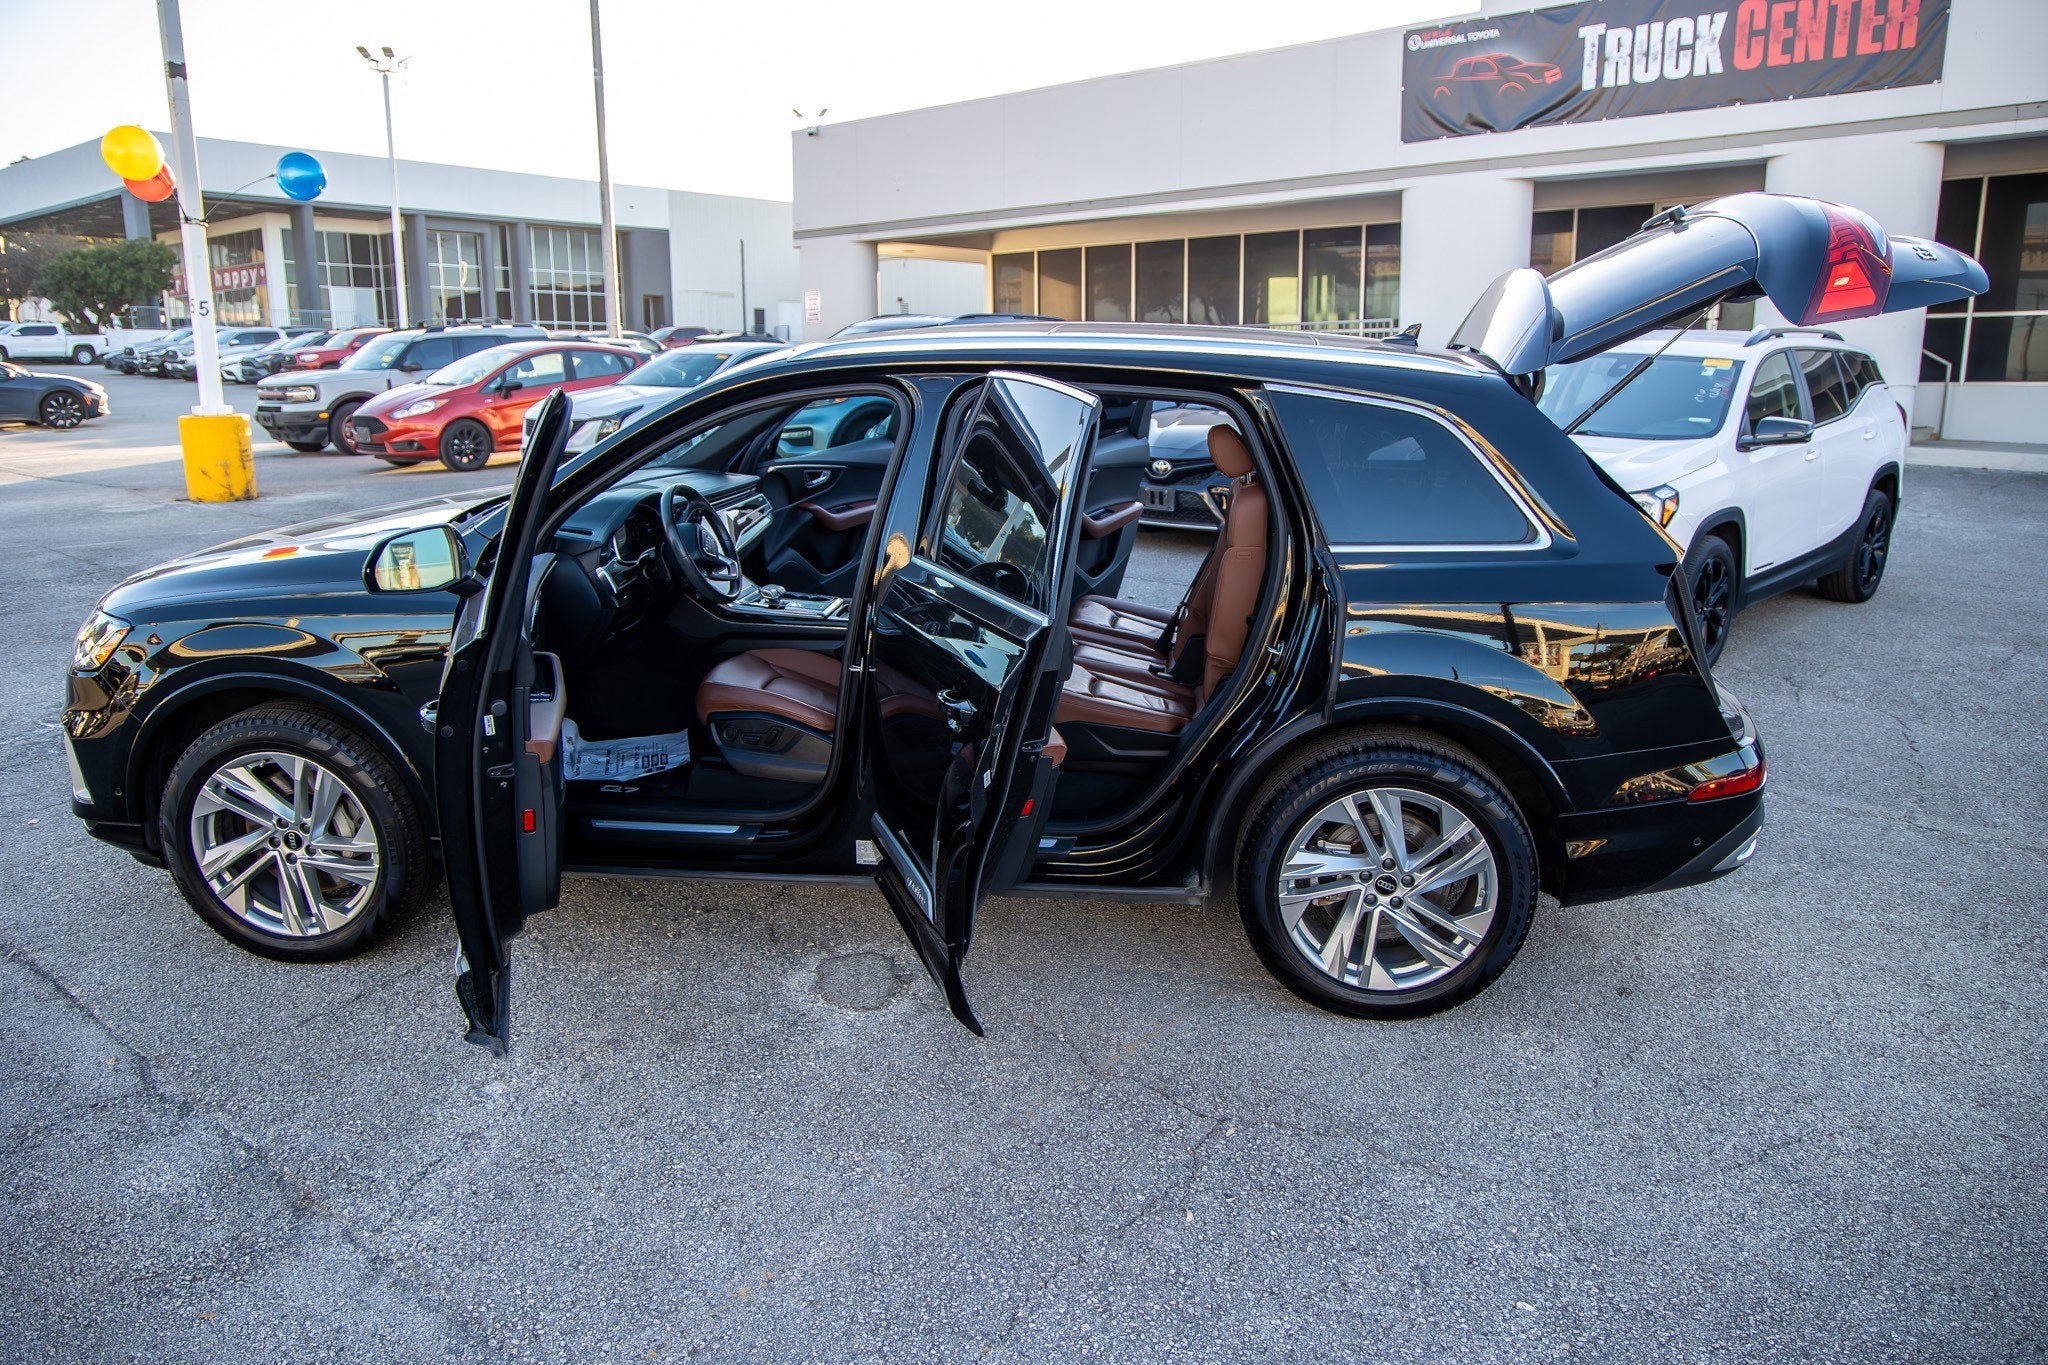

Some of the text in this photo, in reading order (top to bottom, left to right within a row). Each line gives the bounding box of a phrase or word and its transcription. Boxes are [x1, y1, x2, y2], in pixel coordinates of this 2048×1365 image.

[1420, 34, 1467, 49] UNIVERSAL
[1467, 28, 1500, 42] TOYOTA
[1578, 0, 1920, 92] TRUCK CENTER
